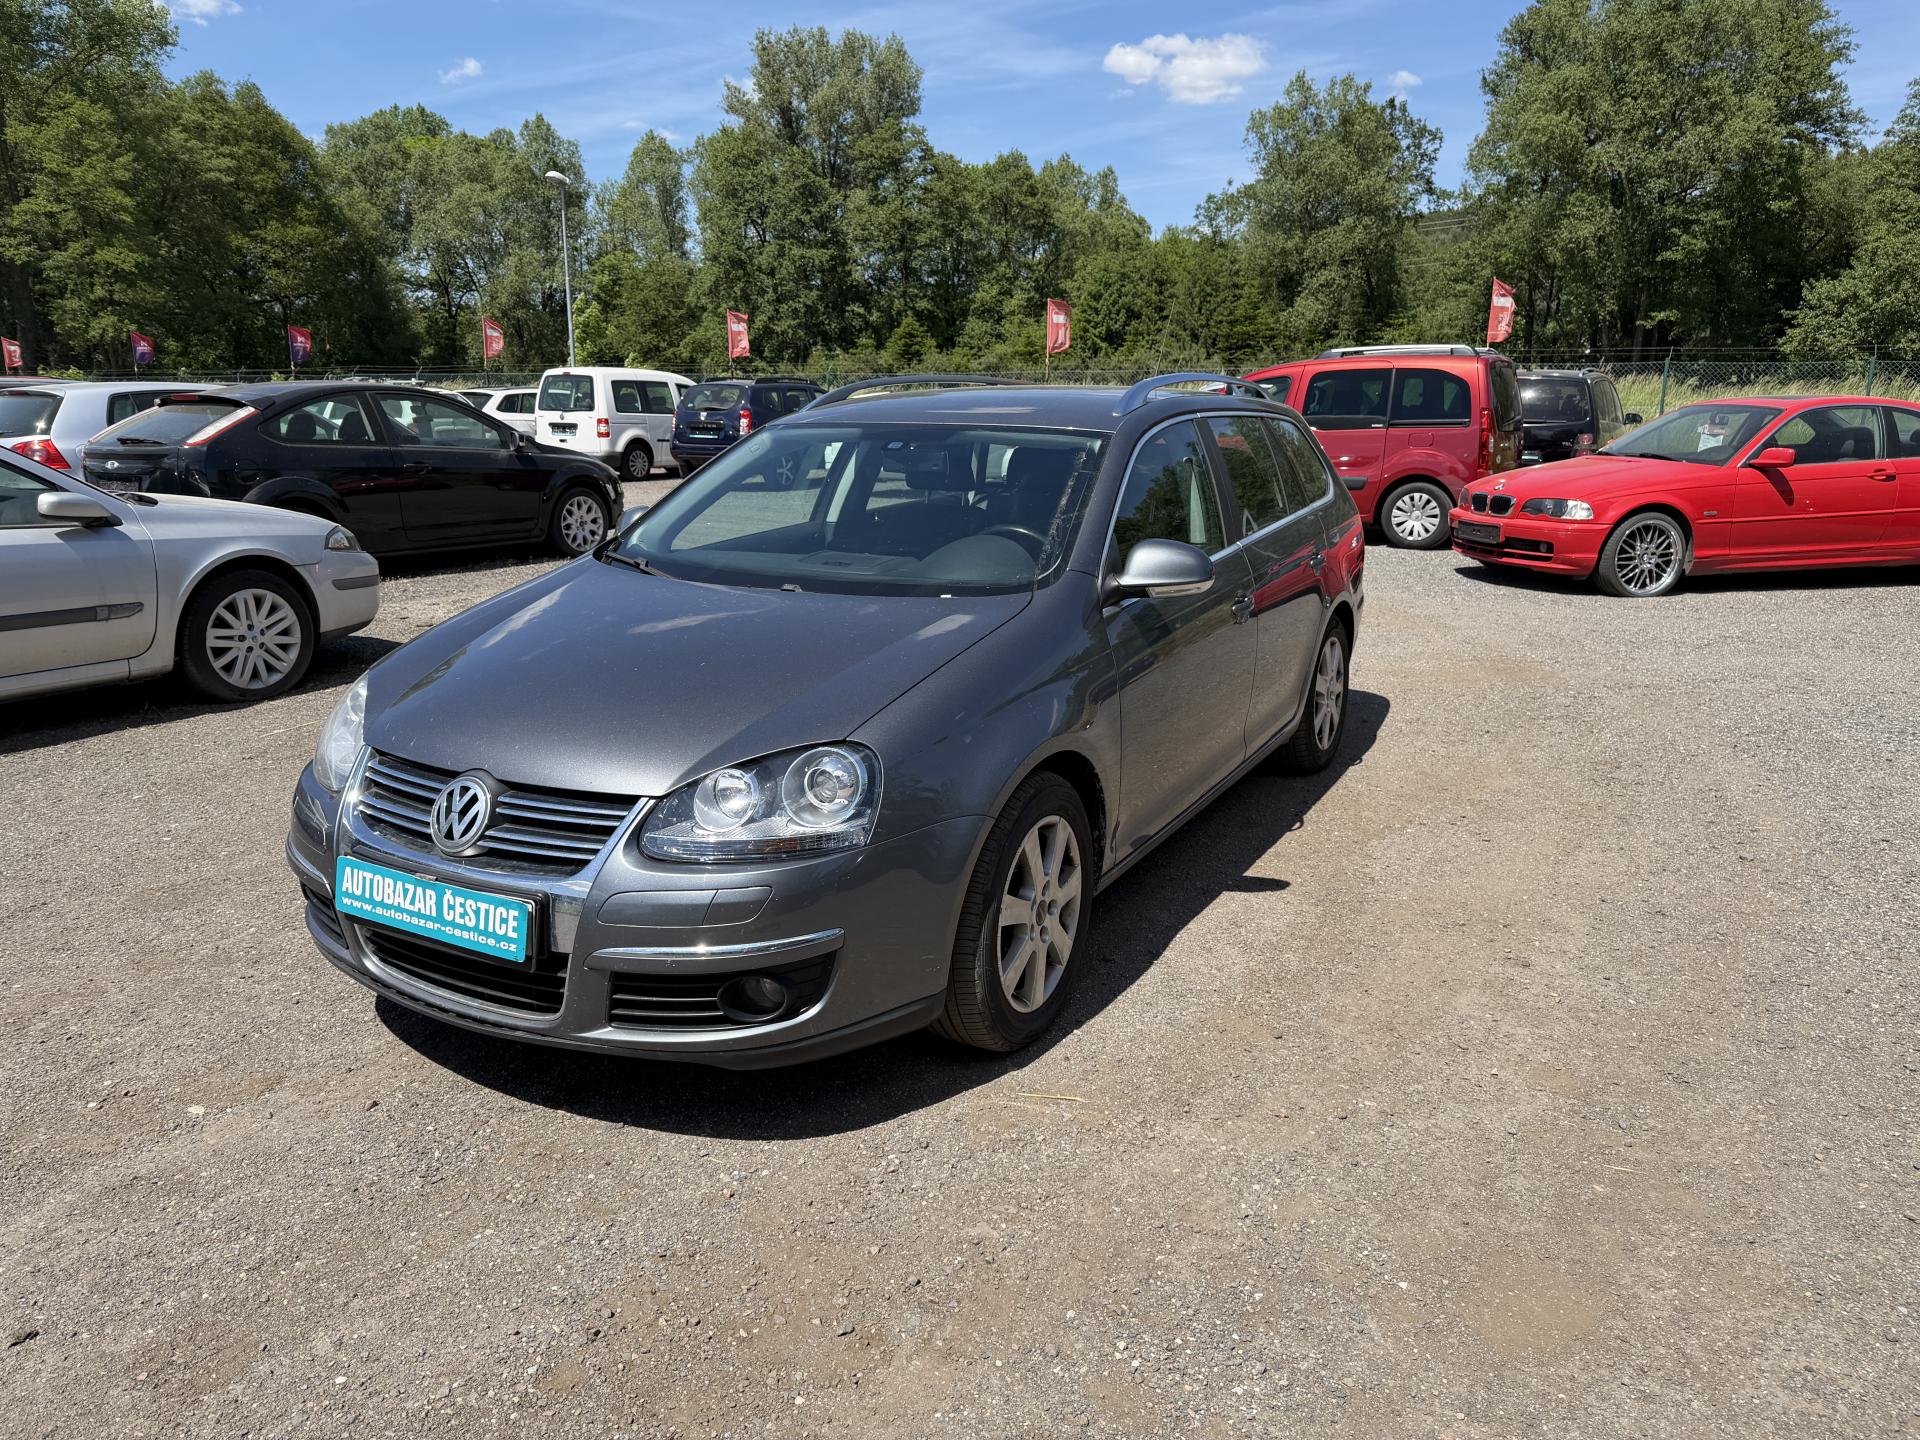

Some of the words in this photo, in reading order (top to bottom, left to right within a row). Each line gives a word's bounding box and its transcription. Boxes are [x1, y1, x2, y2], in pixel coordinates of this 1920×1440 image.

[436, 782, 487, 844] VW
[341, 896, 518, 952] www.autobazar-cestice.cz
[342, 866, 437, 917] AUTOBAZAR
[442, 889, 519, 938] ČESTICE
